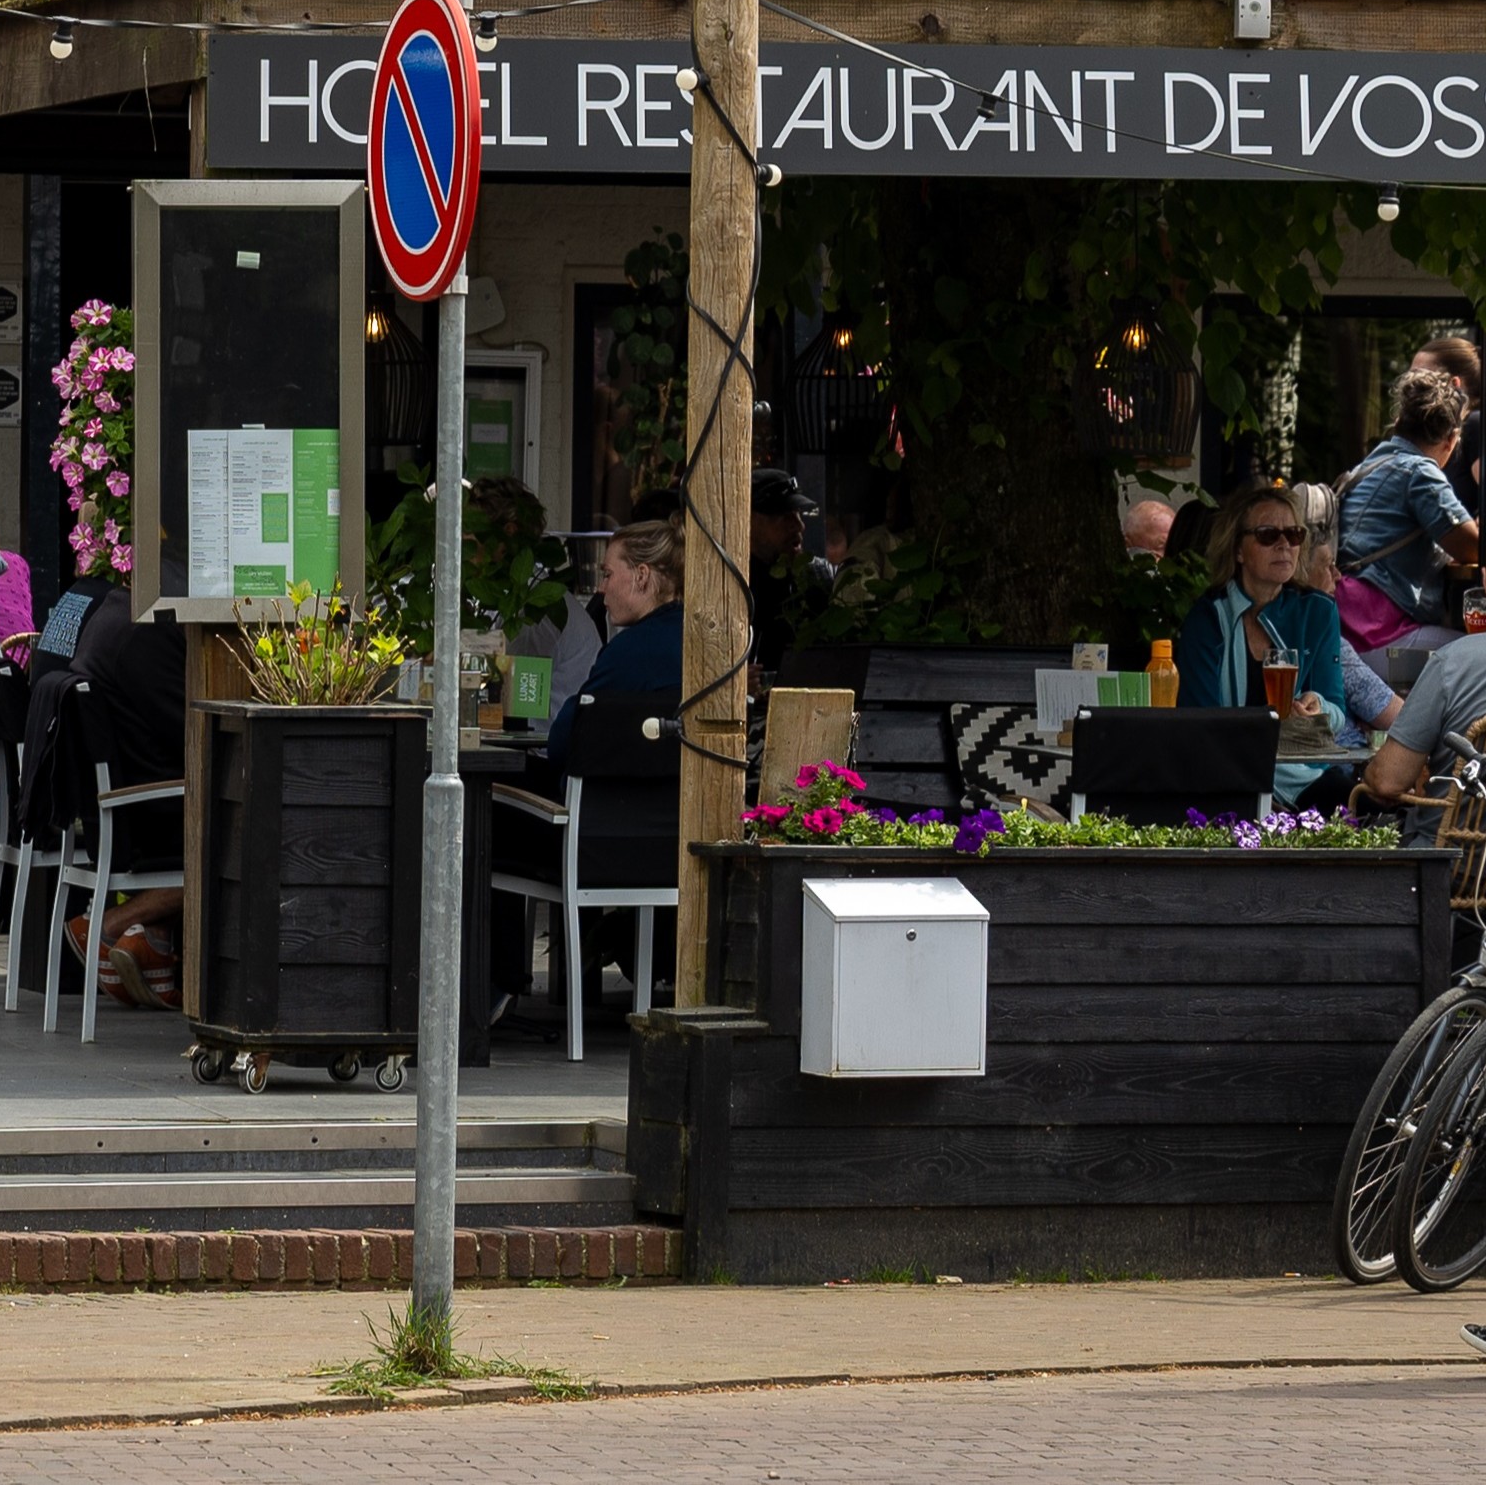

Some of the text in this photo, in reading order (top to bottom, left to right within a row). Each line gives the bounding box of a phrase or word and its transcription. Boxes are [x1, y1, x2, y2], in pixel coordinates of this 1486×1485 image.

[260, 59, 547, 147] HOL
[578, 63, 1135, 153] RETAURANT
[1165, 72, 1272, 156] DE
[519, 671, 529, 701] LUNCH
[528, 672, 540, 703] KAART
